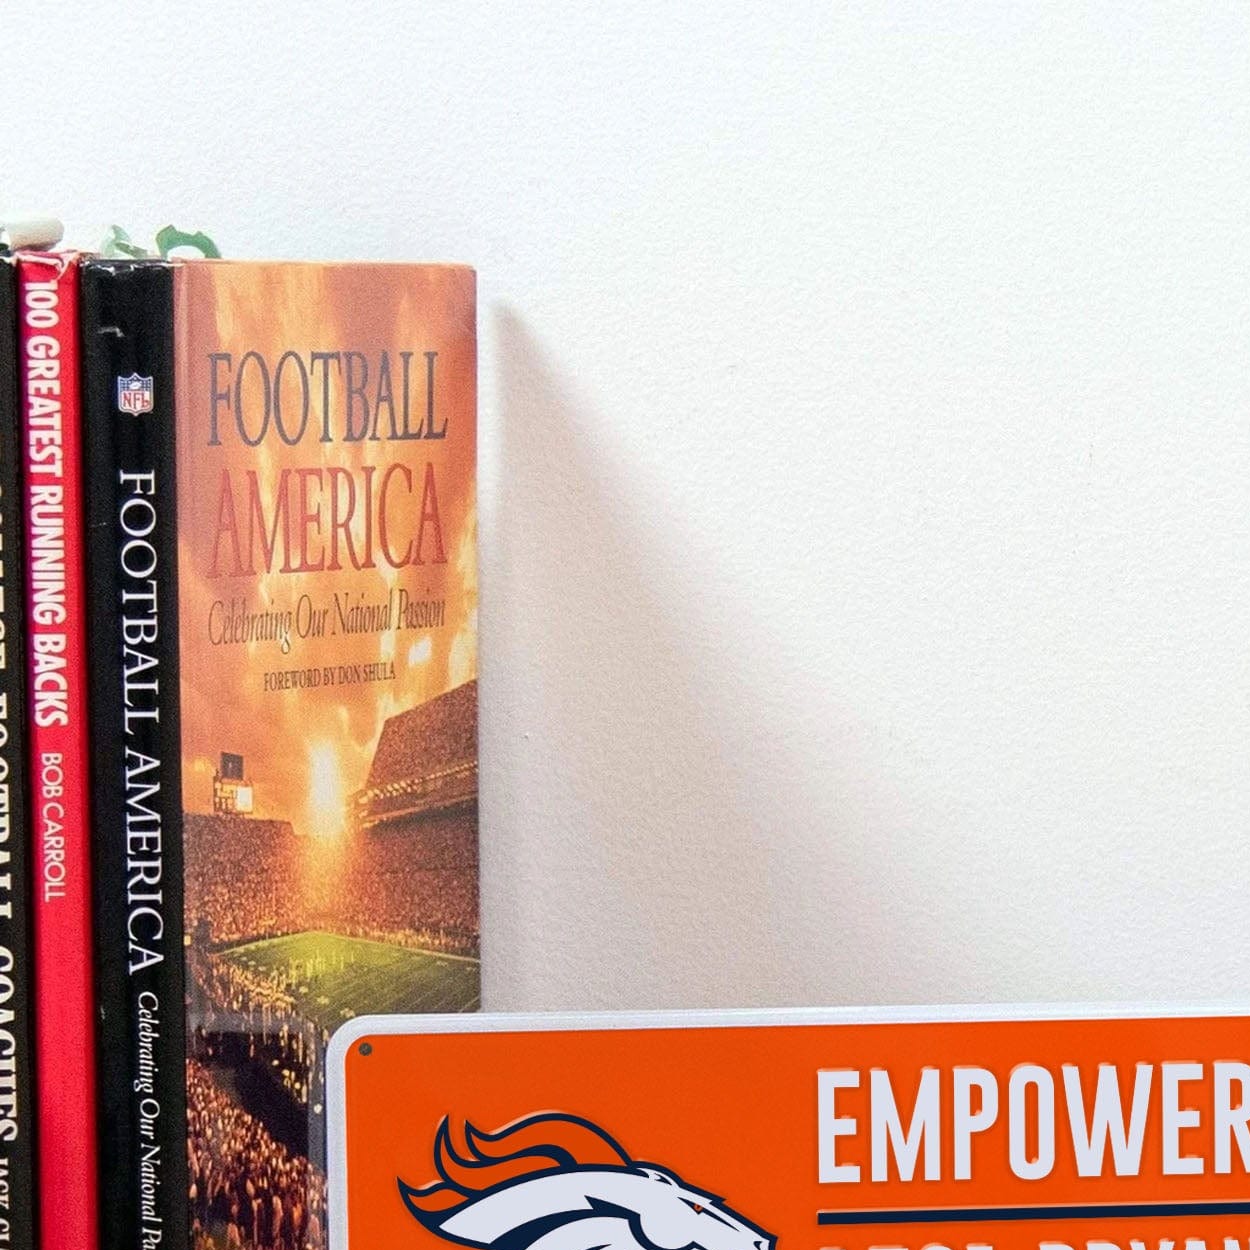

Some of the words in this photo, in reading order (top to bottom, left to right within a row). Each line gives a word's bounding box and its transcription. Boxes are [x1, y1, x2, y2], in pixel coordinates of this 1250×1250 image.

[25, 281, 59, 328] 100
[27, 335, 63, 477] GREATEST
[122, 391, 151, 410] NFL
[206, 351, 447, 447] FOOTBALL
[30, 485, 66, 625] RUNNING
[206, 462, 447, 578] AMERICA
[119, 469, 160, 735] FOOTBALL
[208, 599, 292, 654] Celebrating
[296, 594, 329, 638] Our
[331, 587, 394, 636] National
[396, 587, 446, 630] Passion
[33, 633, 69, 727] BACKS
[264, 668, 321, 692] FOREWORD
[323, 667, 336, 686] BY
[338, 664, 362, 684] DON
[363, 661, 396, 682] SHULA
[41, 752, 64, 798] BOB
[42, 802, 66, 902] CARROLL
[124, 746, 164, 976] AMERICA
[134, 991, 160, 1093] Celebrating
[140, 1099, 161, 1139] Our
[141, 1144, 162, 1222] National
